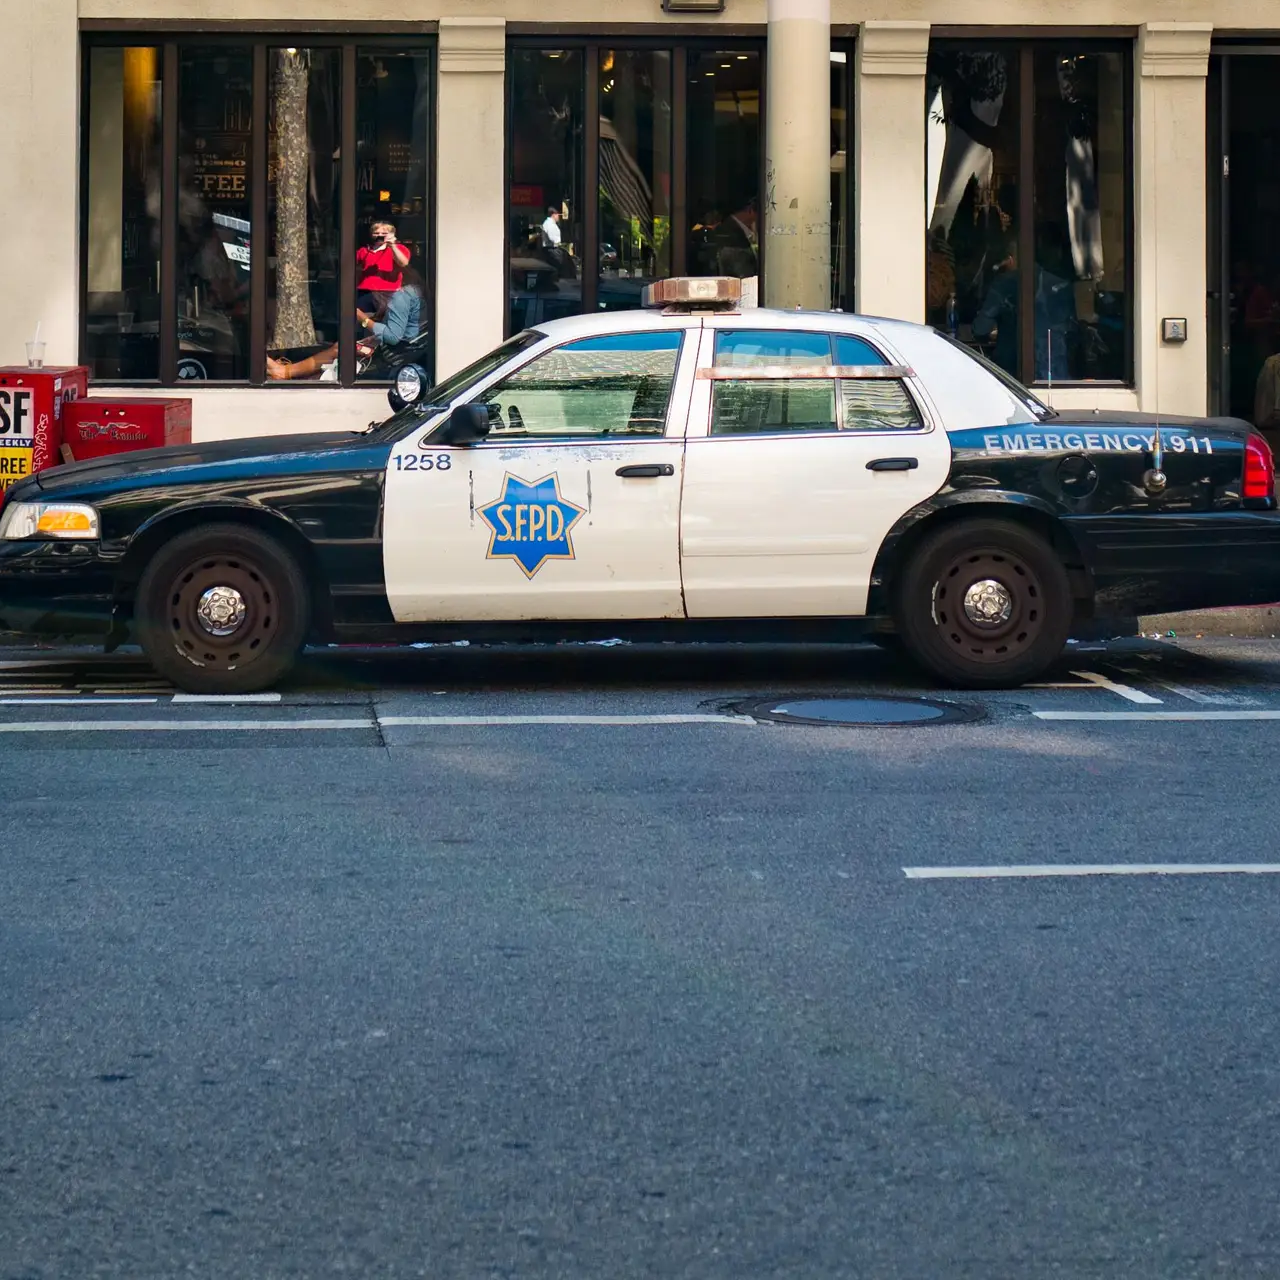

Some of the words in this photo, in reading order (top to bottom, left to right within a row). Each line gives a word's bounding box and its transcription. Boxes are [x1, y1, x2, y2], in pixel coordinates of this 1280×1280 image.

[983, 434, 1157, 452] EMERGENCY
[1170, 435, 1213, 455] 911
[393, 454, 452, 471] 1258
[496, 504, 564, 541] S.F.P.D.
